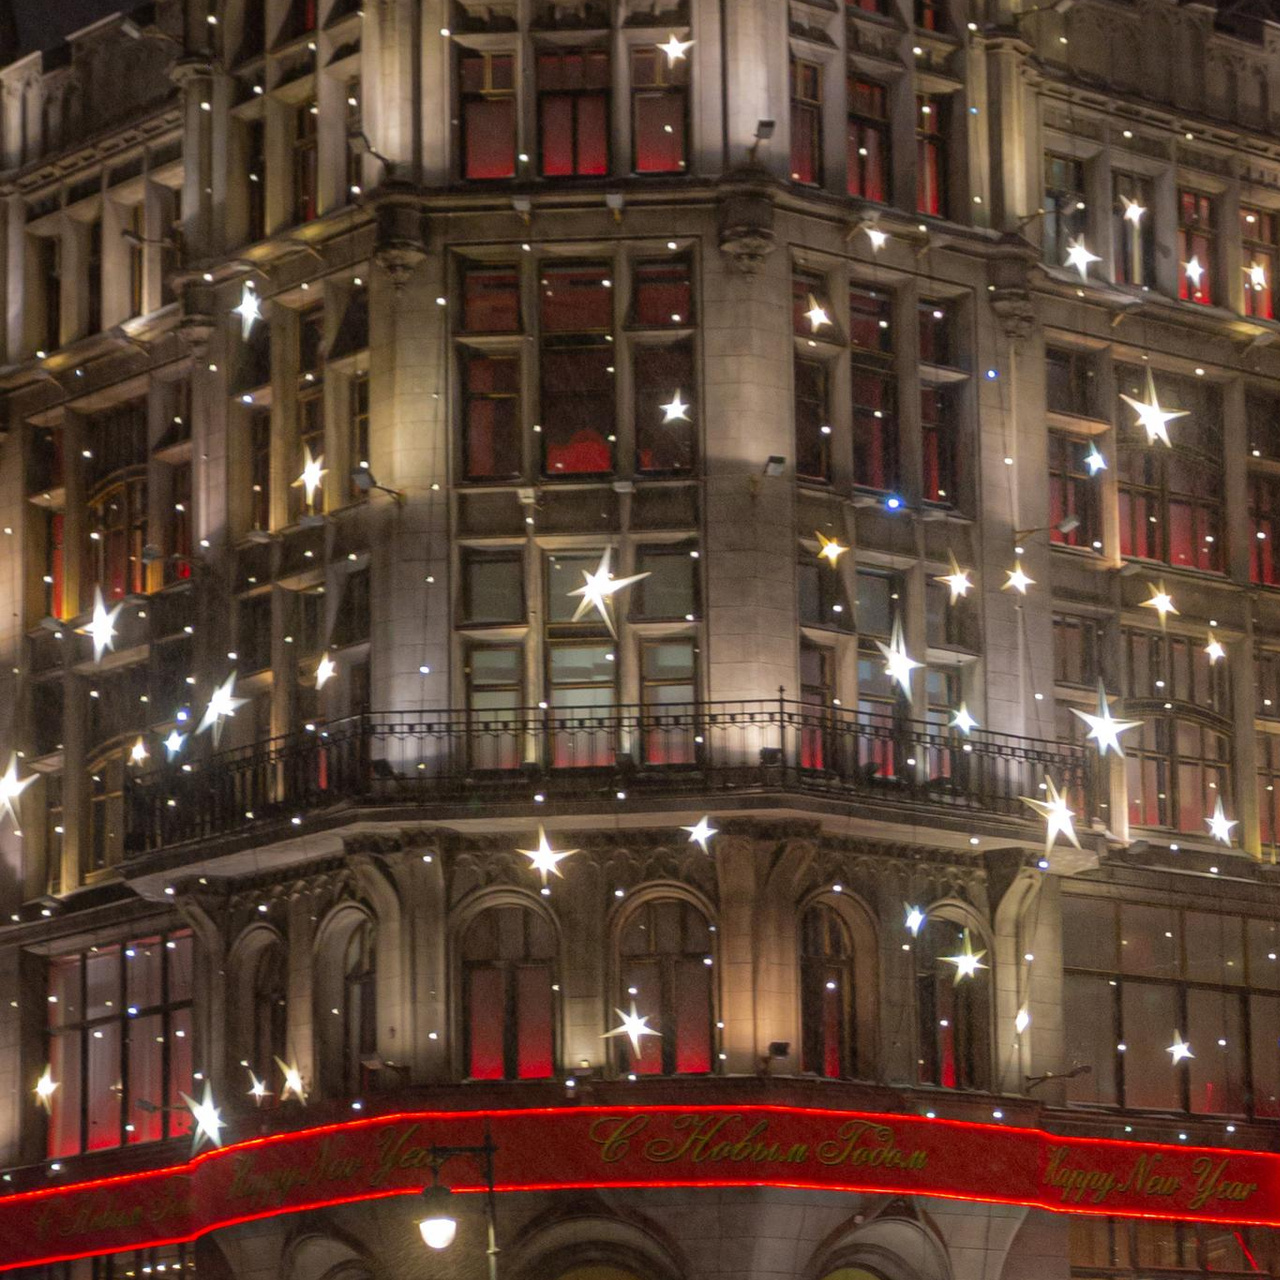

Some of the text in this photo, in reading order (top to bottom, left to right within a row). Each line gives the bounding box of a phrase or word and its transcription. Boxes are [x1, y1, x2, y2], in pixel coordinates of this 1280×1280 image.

[645, 1113, 809, 1164] Новым
[817, 1118, 929, 1170] Годом
[1041, 1144, 1259, 1210] Happy New Year
